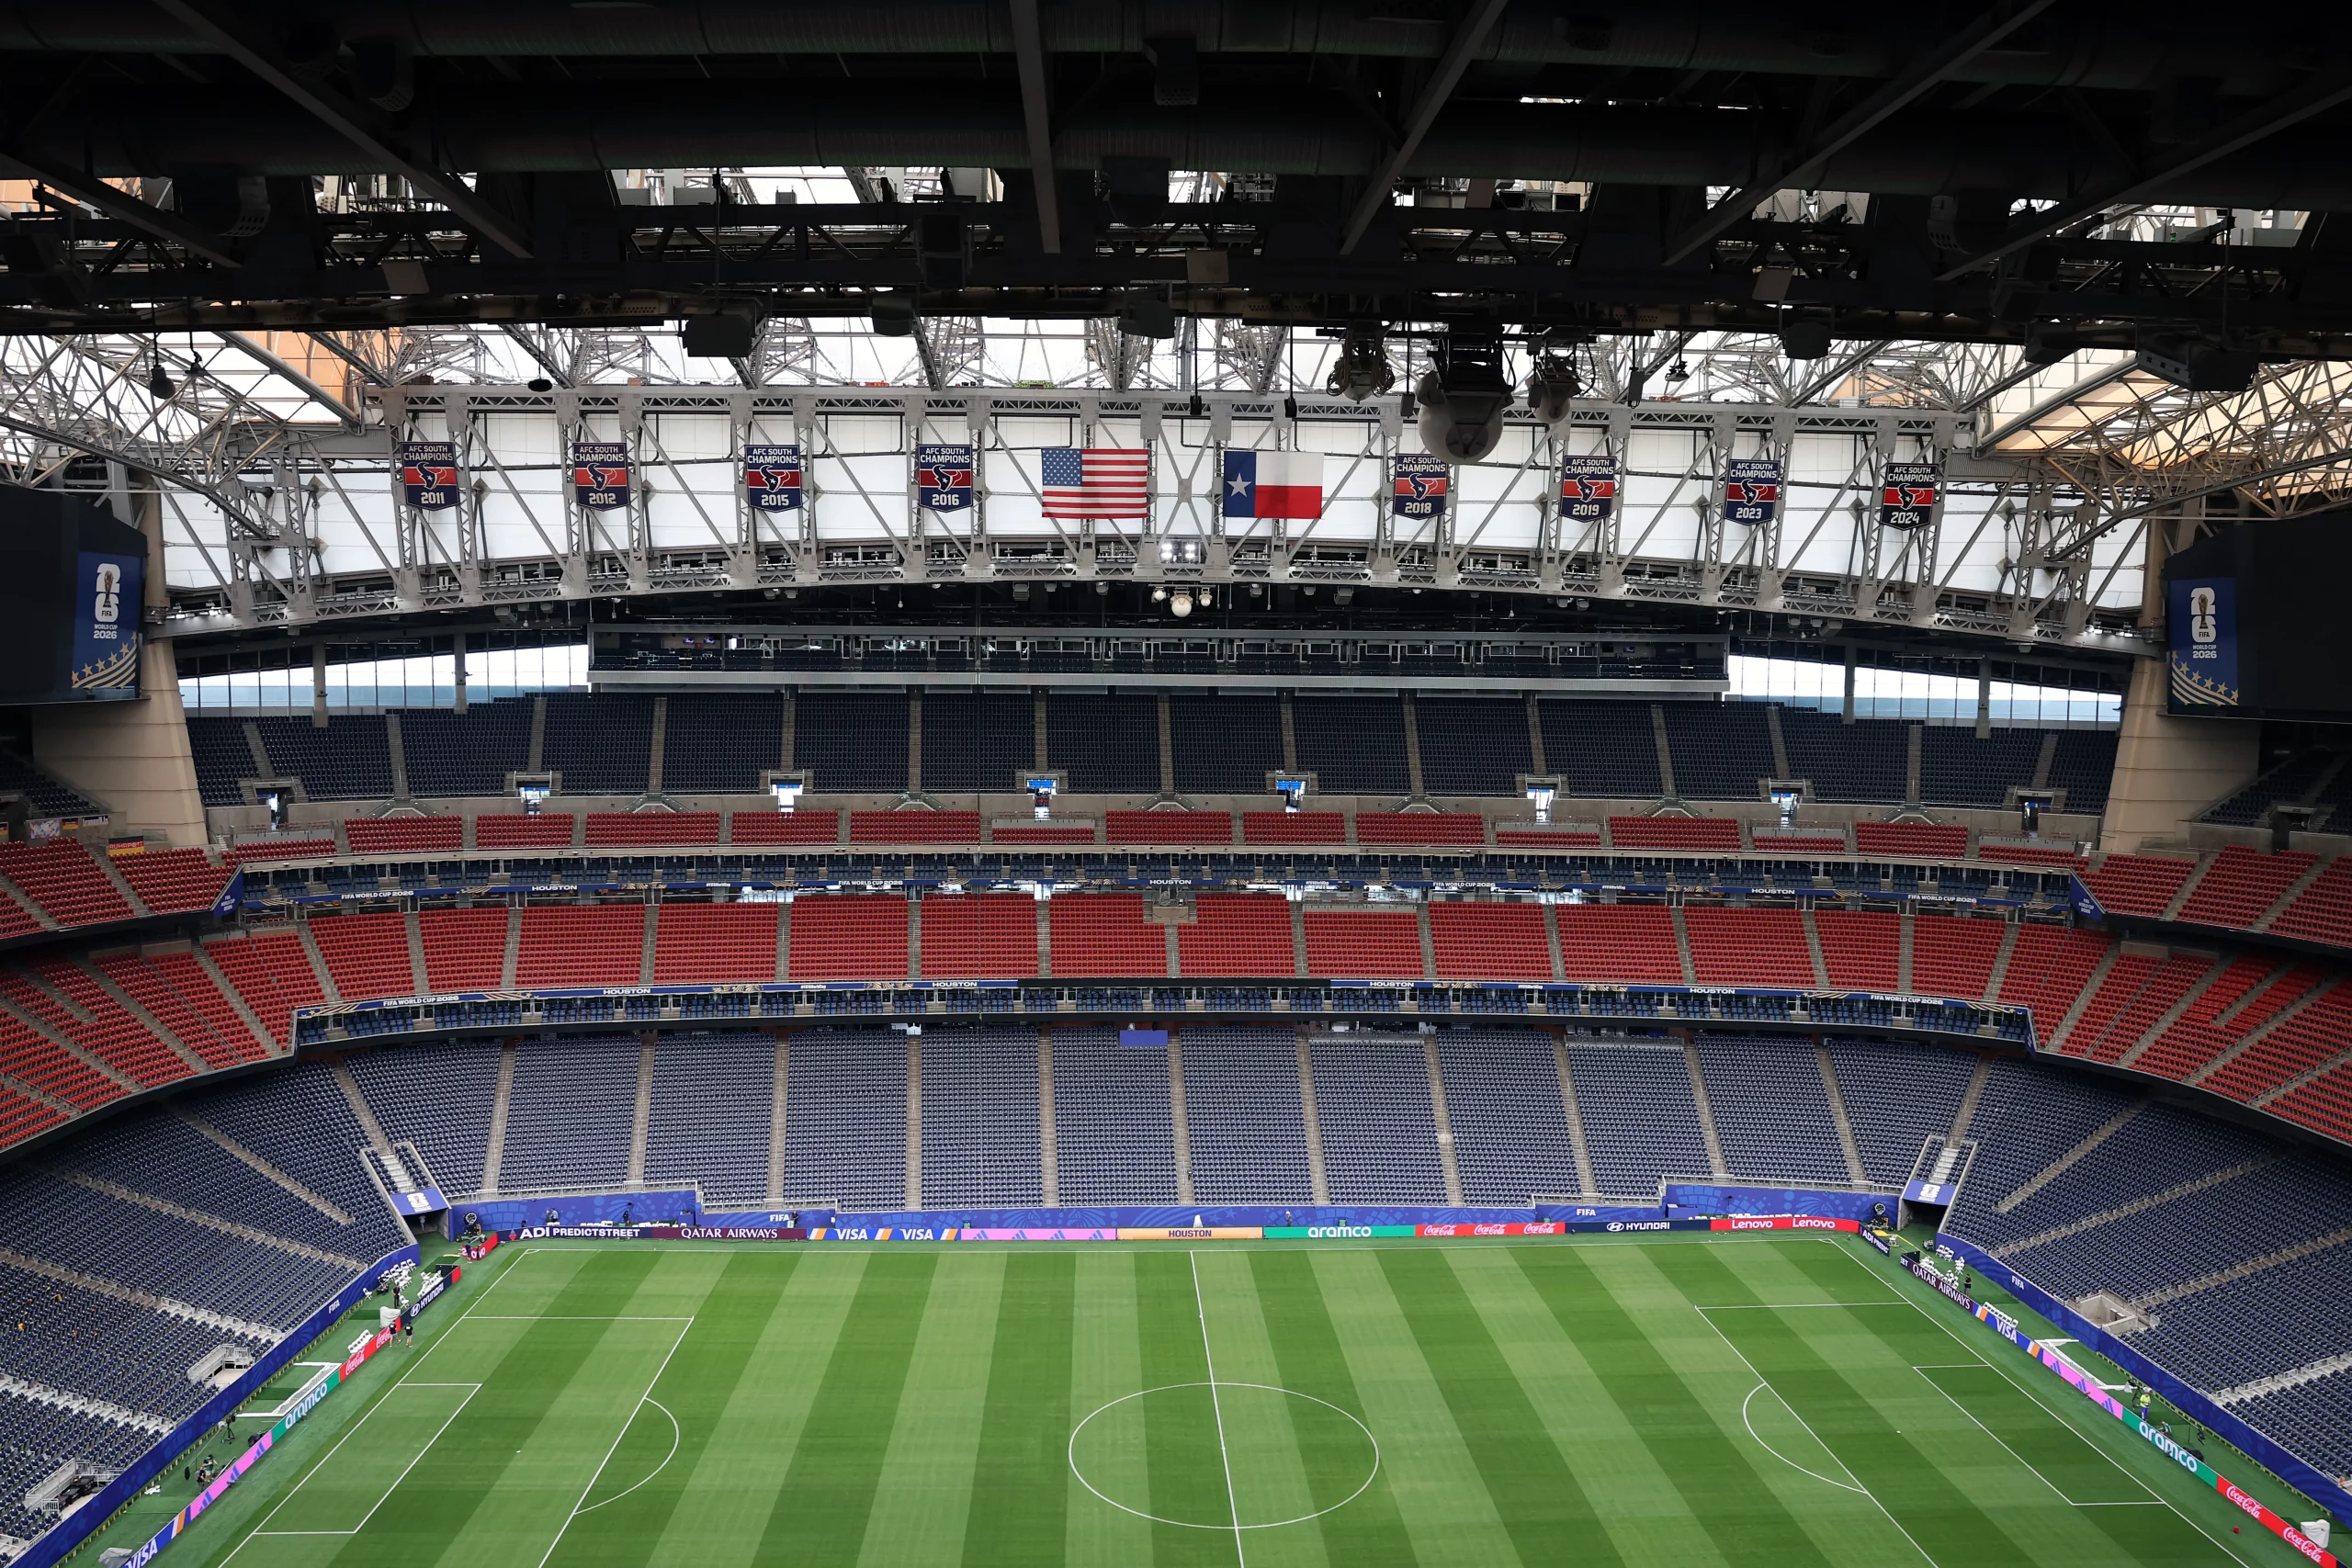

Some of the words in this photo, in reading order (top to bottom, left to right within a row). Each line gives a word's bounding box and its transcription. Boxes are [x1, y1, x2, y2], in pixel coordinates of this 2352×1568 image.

[403, 453, 453, 461] CHAMPIONS
[574, 454, 624, 462] CHAMPIONS
[747, 456, 797, 464] CHAMPIONS
[920, 455, 970, 464] CHAMPIONS
[1397, 464, 1446, 472] CHAMPIONS
[1566, 466, 1613, 475] CHAMPIONS
[1908, 467, 1931, 475] SOUTH
[1731, 469, 1777, 479] CHAMPIONS
[1888, 474, 1935, 482] CHAMPIONS
[421, 492, 445, 503] 2011
[589, 493, 616, 504] 2012
[762, 494, 789, 506] 2015
[932, 494, 959, 506] 2016
[1405, 502, 1431, 513] 2018
[1572, 504, 1600, 516] 2019
[1736, 508, 1762, 519] 2023
[1890, 513, 1920, 524] 2024
[94, 630, 117, 639] 2026
[2193, 650, 2217, 659] 2026
[1577, 1208, 1596, 1216] FIFA
[1626, 1222, 1670, 1231] HYUNDAI
[1732, 1220, 1773, 1229] Lenovo
[1792, 1218, 1836, 1228] Lenovo
[520, 1227, 549, 1239] ADI
[552, 1228, 640, 1237] PREDICTSTREET
[681, 1228, 722, 1239] QATAR
[727, 1229, 778, 1238] AIRWAYS
[833, 1228, 868, 1240] VISA
[899, 1228, 933, 1240] VISA
[1307, 1226, 1372, 1237] aramco
[1862, 1230, 1873, 1244] ADI
[1913, 1264, 1936, 1289] QATAR
[1939, 1282, 1971, 1310] AIRWAYS
[2011, 1275, 2024, 1291] FIFA
[420, 1282, 444, 1309] HYUNDAI
[329, 1301, 340, 1314] FIFA
[1996, 1317, 2018, 1344] VISA
[285, 1382, 327, 1429] aramco
[2139, 1421, 2198, 1472] aramco
[125, 1539, 158, 1568] VISA
